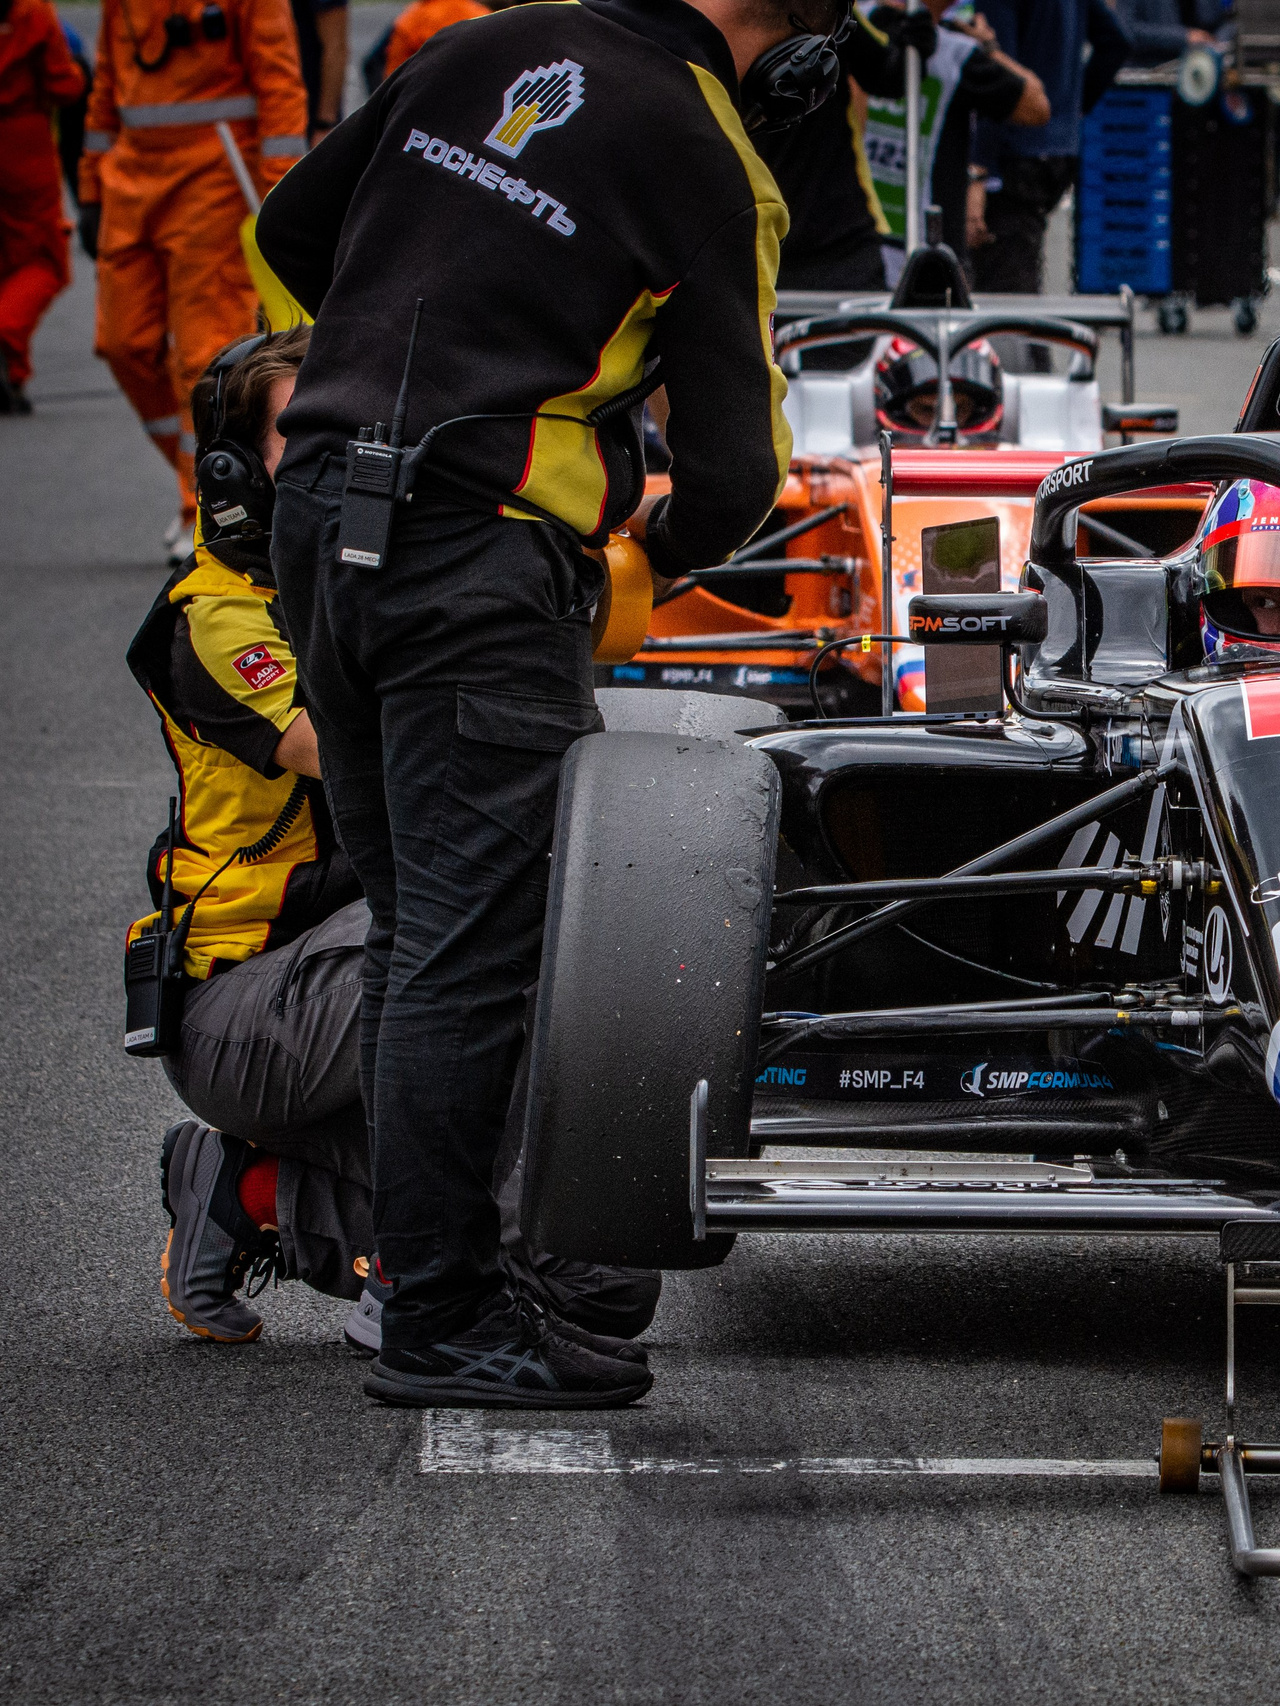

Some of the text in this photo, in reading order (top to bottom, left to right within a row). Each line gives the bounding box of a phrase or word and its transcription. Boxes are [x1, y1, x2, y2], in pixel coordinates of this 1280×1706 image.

[403, 128, 577, 236] РОСНЕФТЬ
[364, 450, 392, 458] MOTOROLA
[251, 663, 277, 685] LADA
[257, 669, 280, 689] SPORT
[839, 1069, 925, 1088] #SMP_F4
